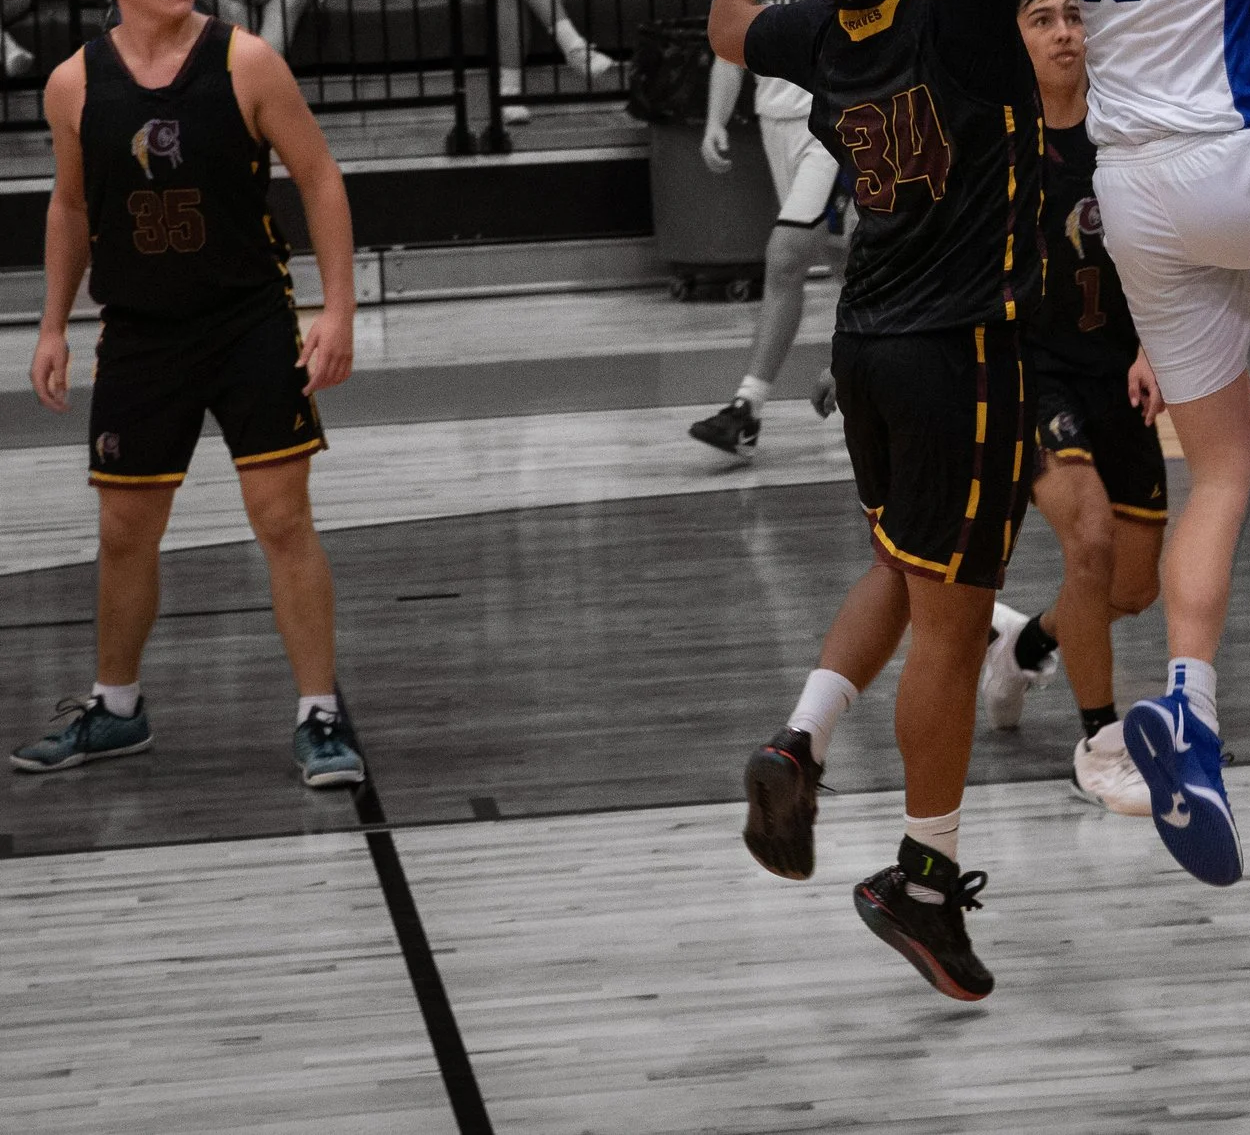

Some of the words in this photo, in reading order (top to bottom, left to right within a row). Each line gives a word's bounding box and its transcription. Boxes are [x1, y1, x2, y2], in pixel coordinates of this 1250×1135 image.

[836, 84, 951, 213] 34
[127, 187, 206, 255] 35
[1075, 266, 1107, 333] 1
